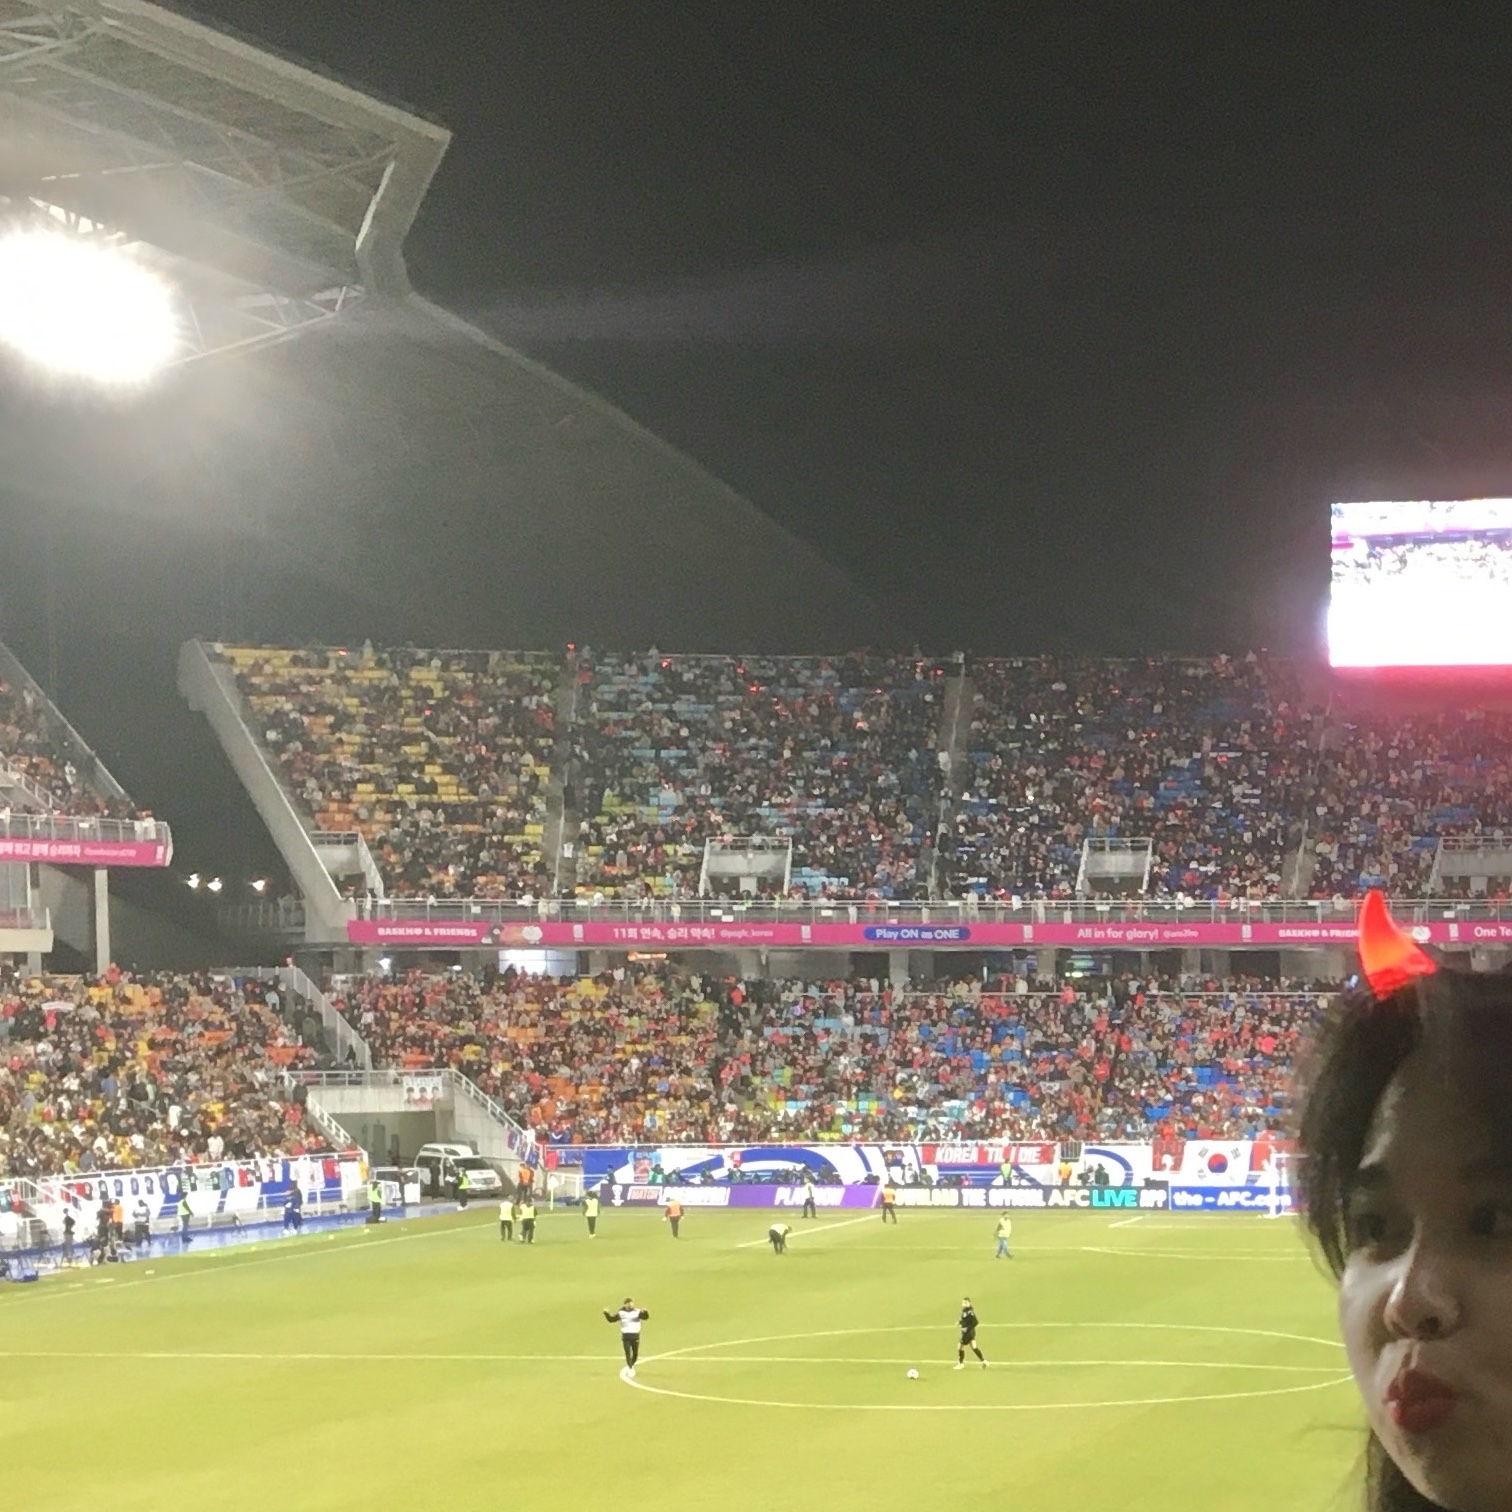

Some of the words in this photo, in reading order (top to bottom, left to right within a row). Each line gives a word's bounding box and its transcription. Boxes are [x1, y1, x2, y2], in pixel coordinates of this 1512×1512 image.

[434, 927, 478, 938] FRIENDS
[875, 928, 898, 941] Play
[901, 928, 919, 940] ON
[934, 928, 960, 940] ONE
[1077, 927, 1093, 939] All
[1094, 927, 1105, 939] in
[1106, 927, 1124, 939] for
[1126, 927, 1159, 941] glory!
[1474, 926, 1497, 938] One
[934, 1146, 979, 1164] KOREA
[1018, 1146, 1042, 1164] DIE
[1048, 1189, 1090, 1207] AFC
[1092, 1190, 1138, 1207] LIVE
